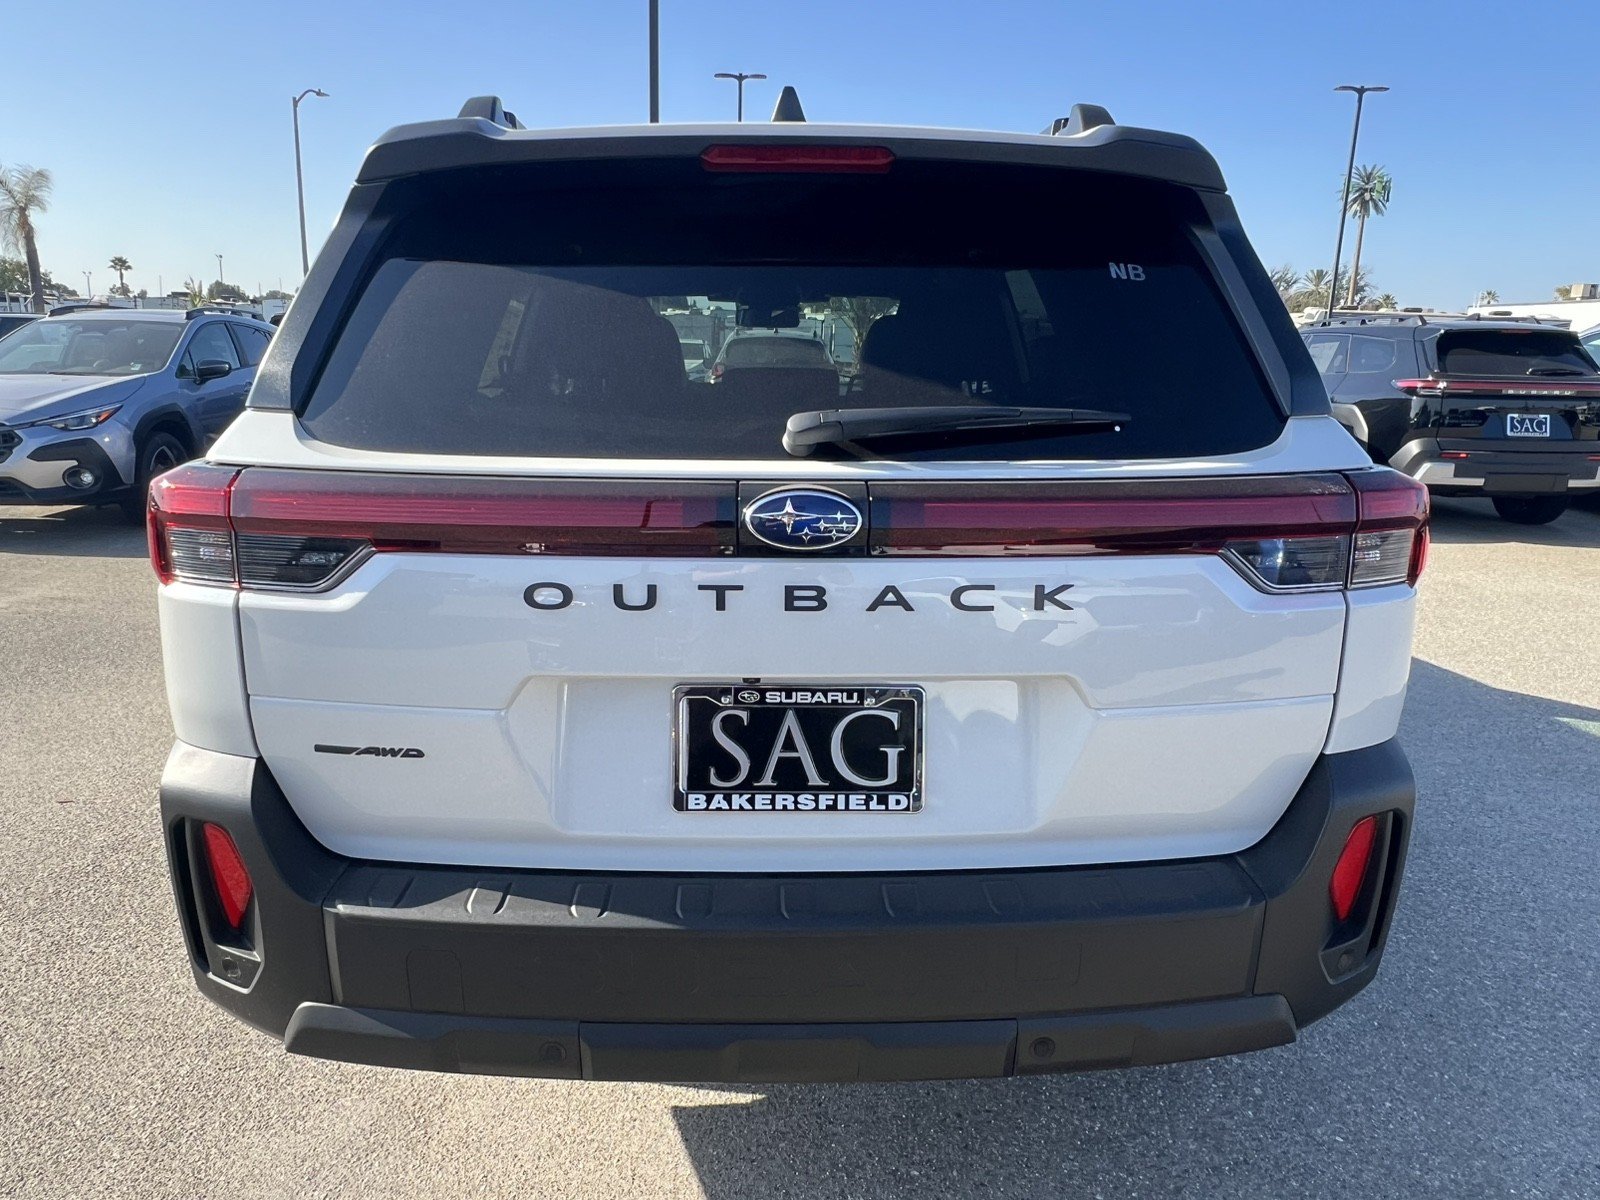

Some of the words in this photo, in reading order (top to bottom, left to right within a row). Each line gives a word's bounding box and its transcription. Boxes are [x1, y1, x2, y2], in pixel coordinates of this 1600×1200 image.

[1513, 418, 1546, 433] SAG
[523, 582, 1075, 612] OUTBACK
[765, 690, 858, 704] SUBARU
[708, 708, 905, 787] SAG
[687, 793, 909, 810] BAKERSFIELD
